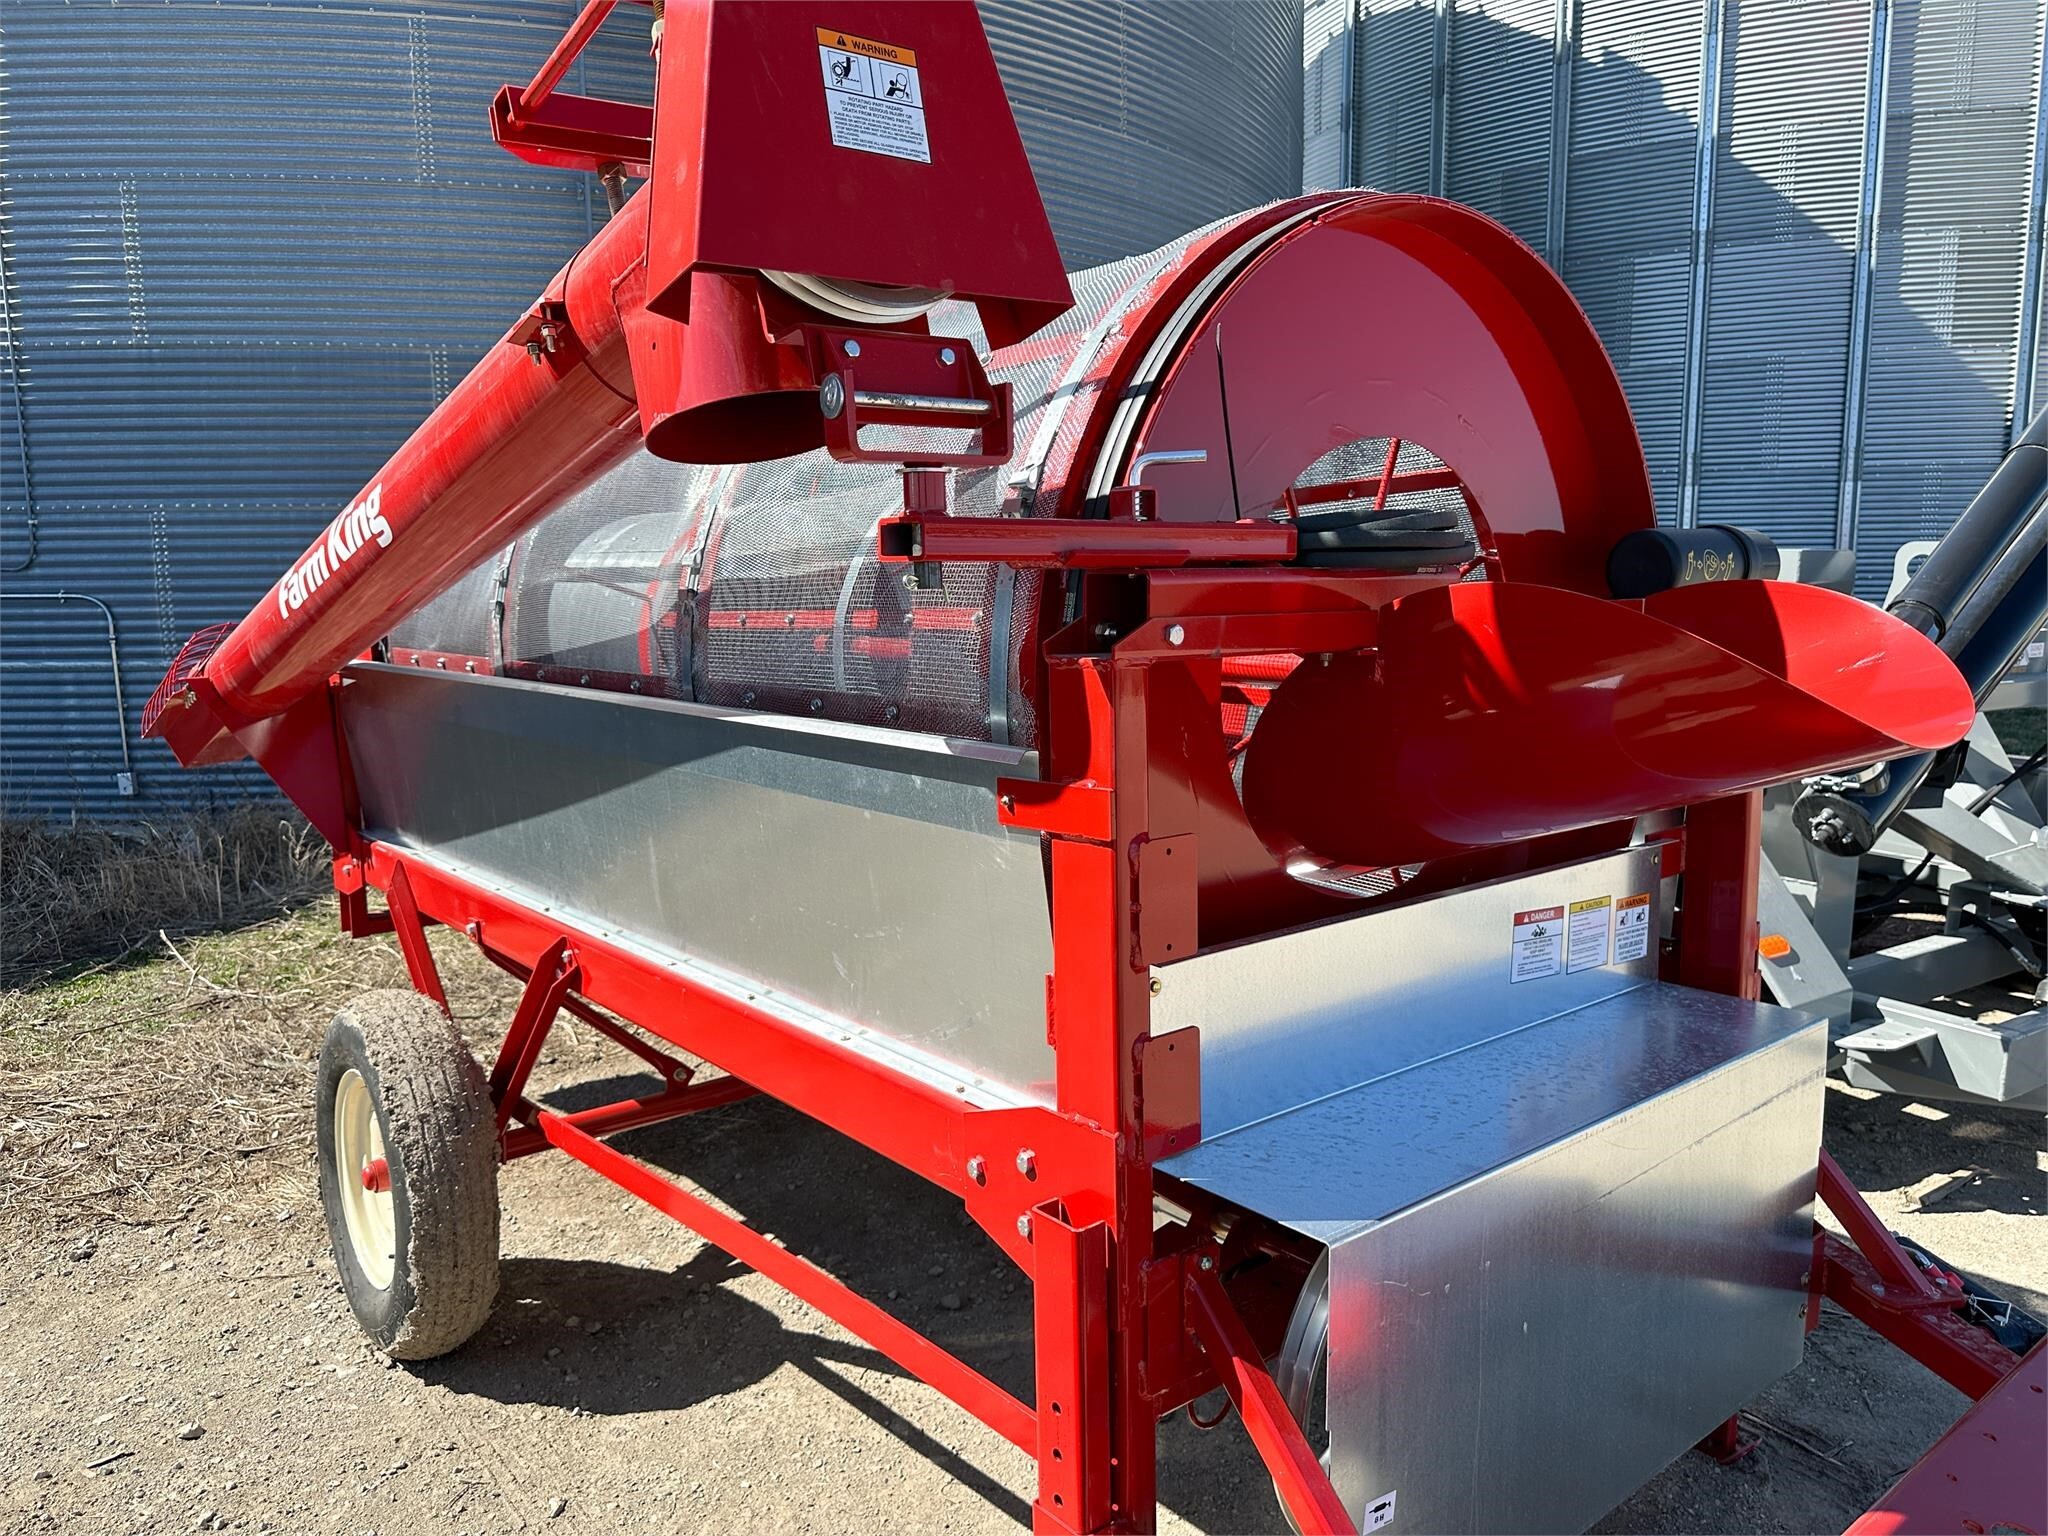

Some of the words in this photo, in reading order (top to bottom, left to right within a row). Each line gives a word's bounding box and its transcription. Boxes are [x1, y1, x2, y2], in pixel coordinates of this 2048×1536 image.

[851, 40, 898, 58] WARNING
[846, 101, 867, 110] PREVENT
[279, 544, 330, 620] Farm
[327, 482, 393, 572] King
[1586, 900, 1603, 908] CAUTION
[1624, 896, 1647, 908] WARNING
[1530, 910, 1555, 922] DANGER
